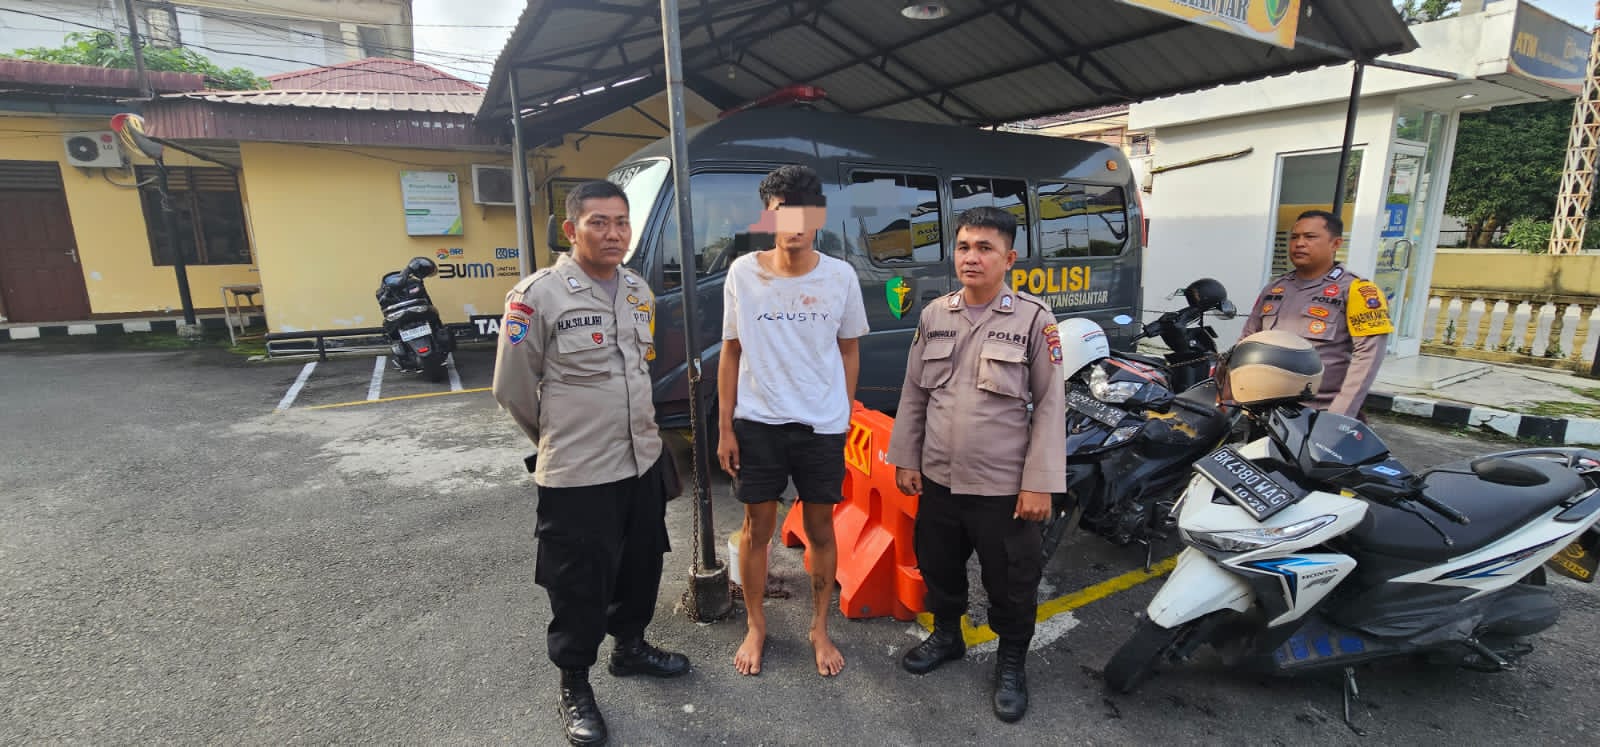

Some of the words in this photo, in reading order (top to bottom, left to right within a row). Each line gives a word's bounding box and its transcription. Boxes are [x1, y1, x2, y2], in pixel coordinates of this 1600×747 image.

[1513, 31, 1538, 58] ATM
[1012, 266, 1091, 294] POLISI
[1311, 296, 1343, 306] POLRI
[987, 331, 1027, 344] POLRI
[1301, 568, 1339, 580] HONDA
